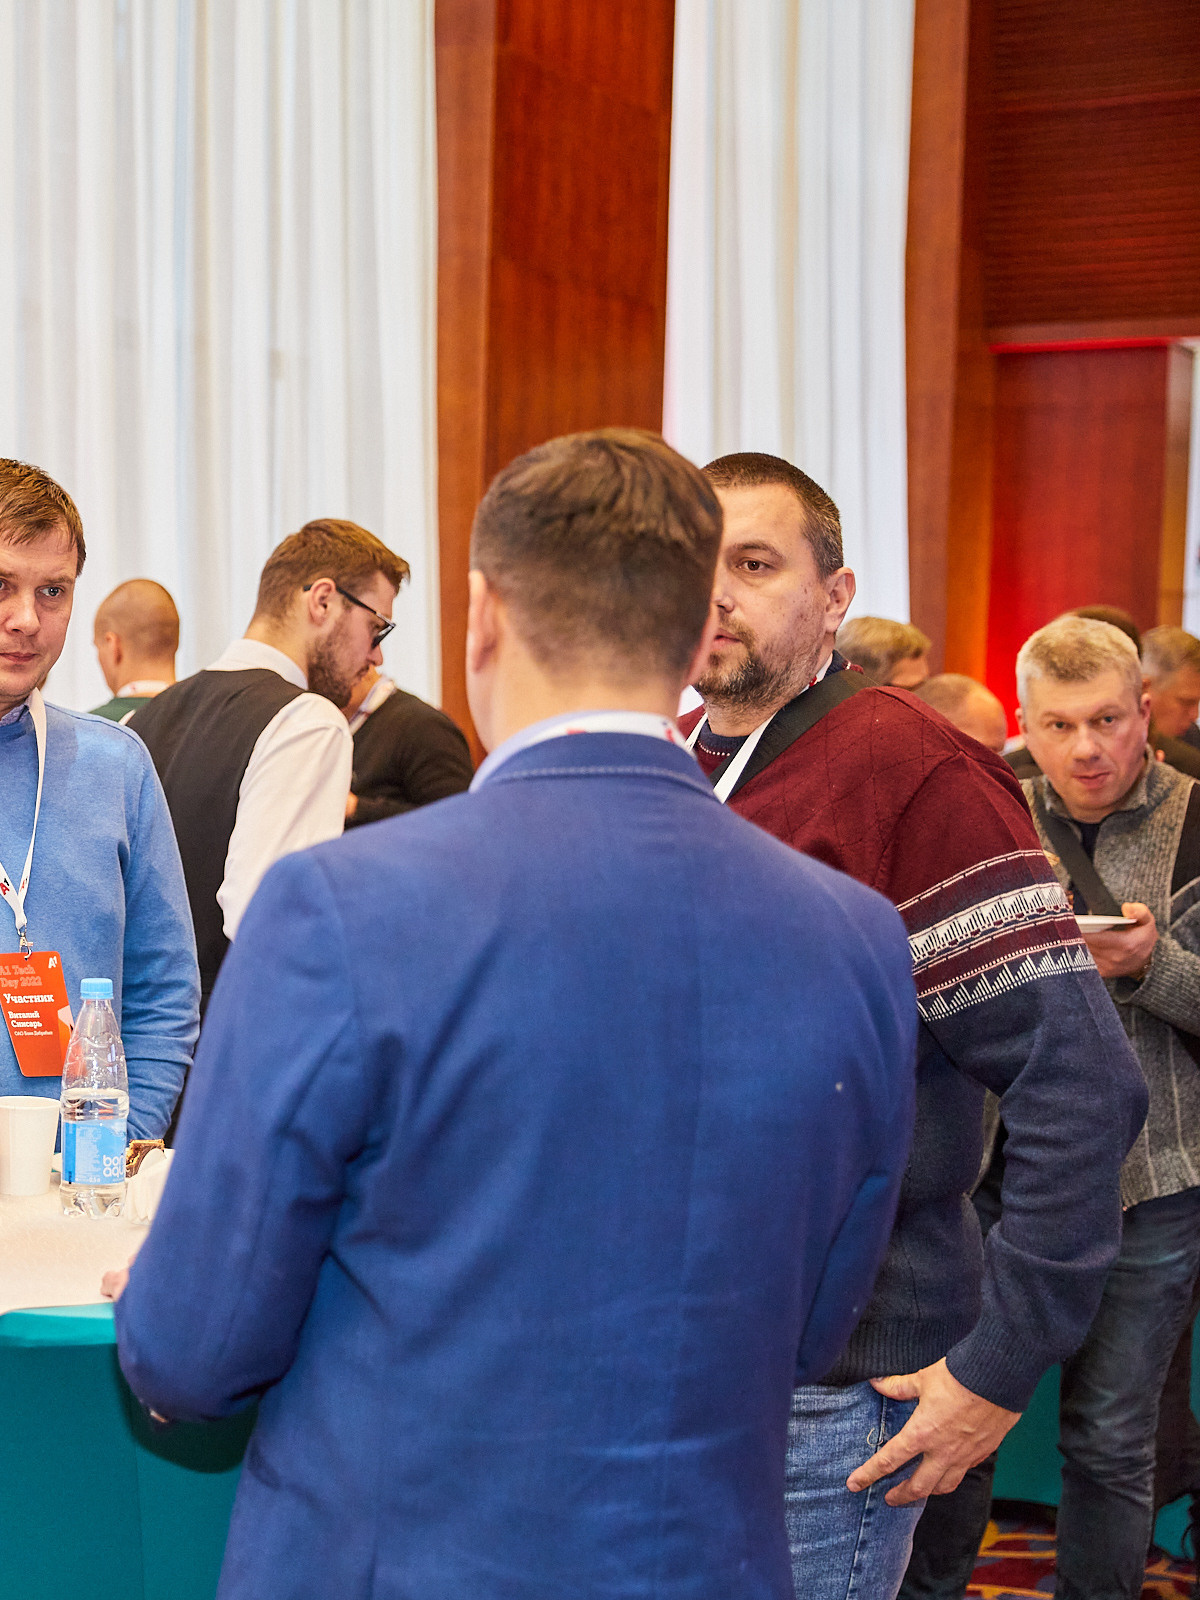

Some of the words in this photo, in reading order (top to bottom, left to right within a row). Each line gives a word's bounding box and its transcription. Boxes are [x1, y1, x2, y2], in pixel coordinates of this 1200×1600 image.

[0, 878, 10, 896] A1
[48, 955, 58, 969] A1
[11, 964, 36, 975] Tech
[0, 977, 19, 989] Day
[19, 975, 43, 987] 2022
[2, 993, 55, 1004] Участник
[103, 1166, 125, 1178] aqu
